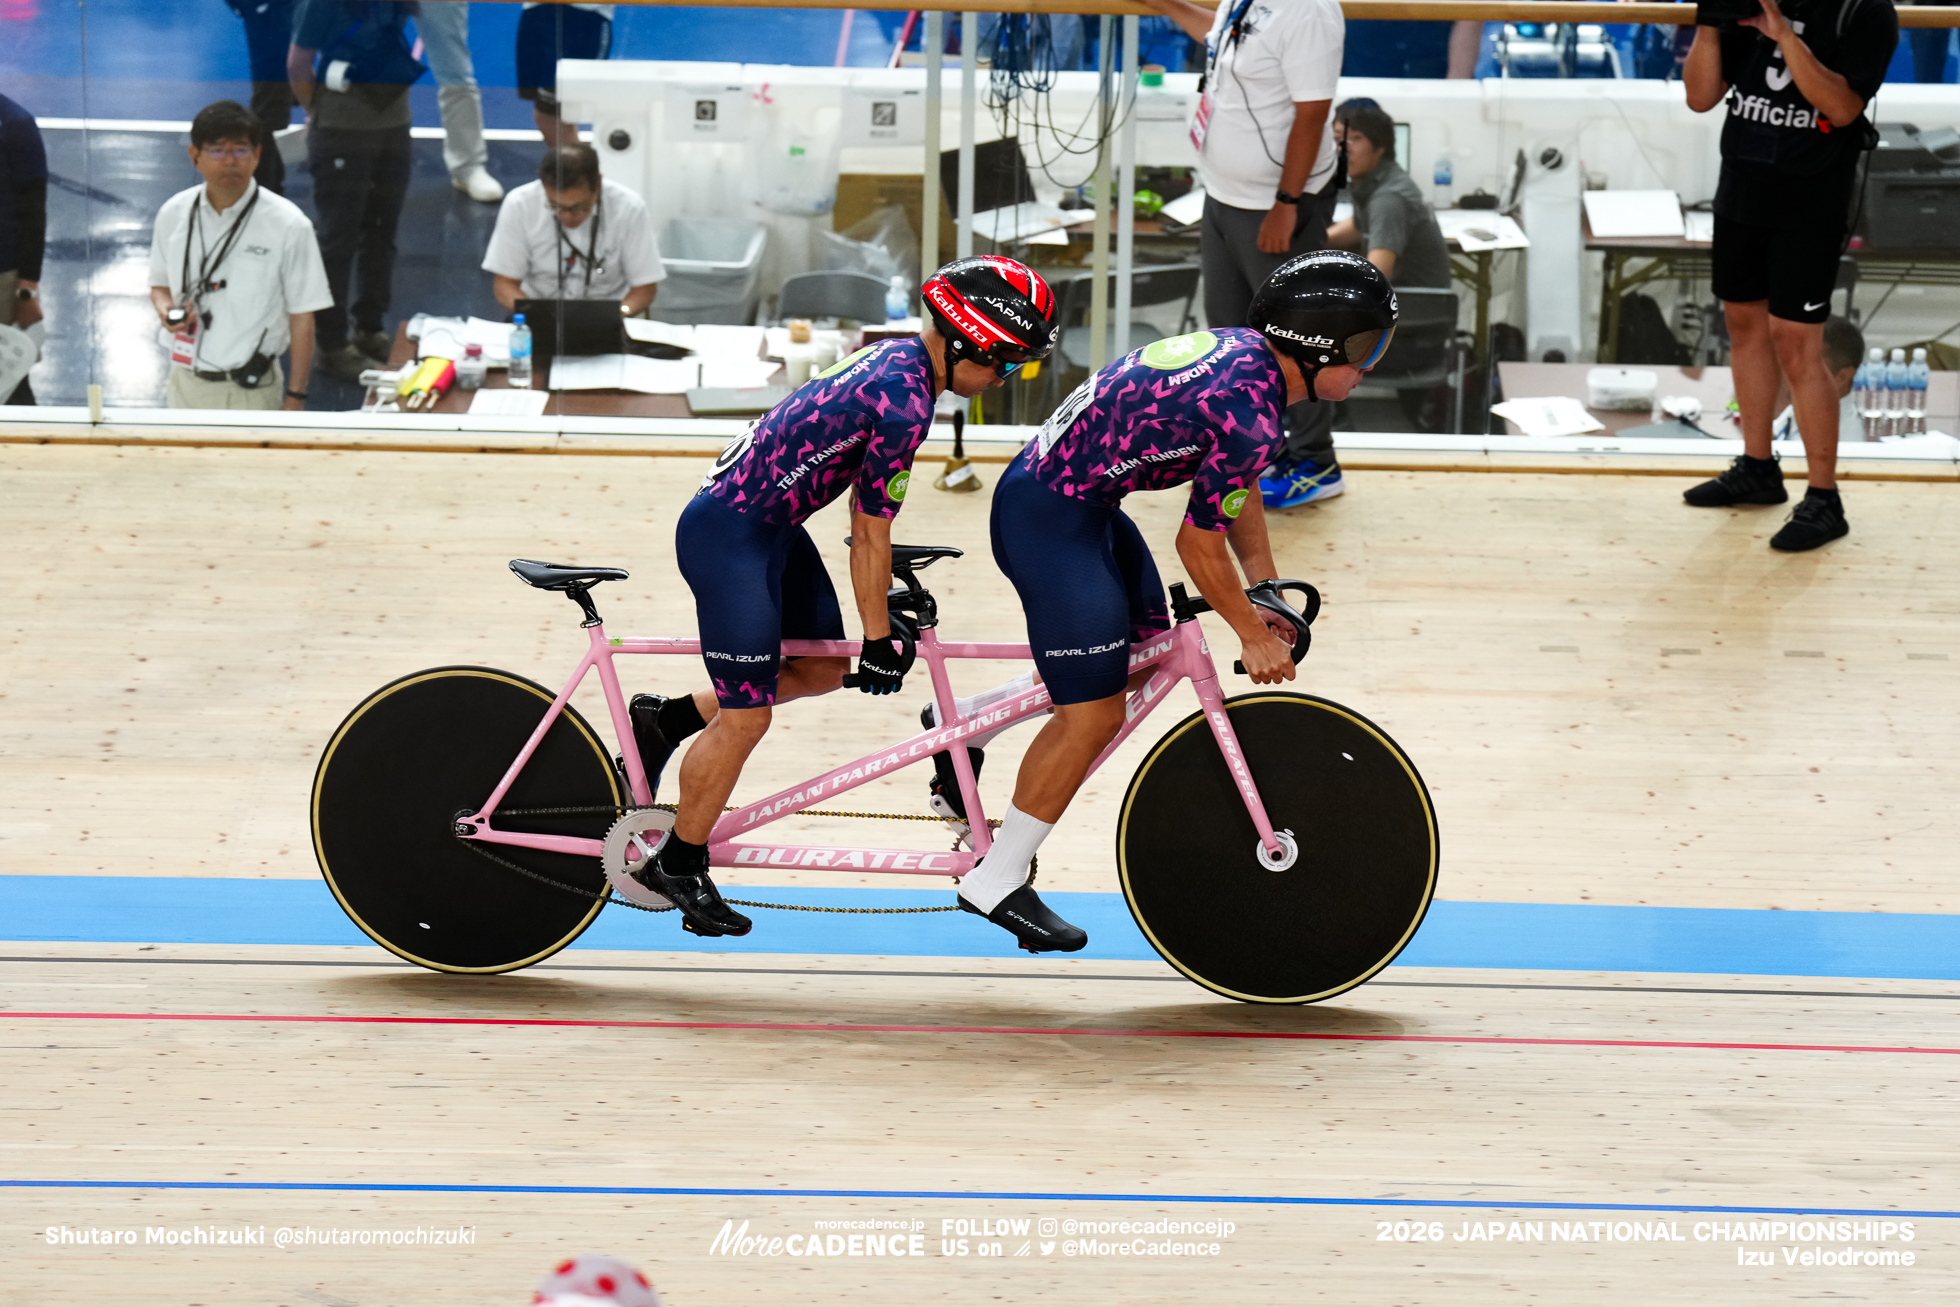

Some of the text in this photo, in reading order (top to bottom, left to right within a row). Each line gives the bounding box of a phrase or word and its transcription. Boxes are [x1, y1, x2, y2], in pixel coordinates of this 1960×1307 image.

[1731, 91, 1819, 128] Official
[929, 286, 988, 343] Kabuto
[985, 297, 1033, 330] JAPAN
[1265, 323, 1334, 345] Kabuto
[1168, 350, 1225, 386] TANDEM
[777, 436, 861, 490] TEAM TANDEM
[1103, 444, 1201, 479] TEAM TANDEM
[706, 651, 734, 661] PEARL
[1045, 648, 1086, 658] PEARL
[742, 783, 824, 826] JAPAN
[832, 705, 1013, 789] PARA-CYCLING
[1210, 711, 1258, 807] DURATEC
[733, 847, 952, 872] DURATEC
